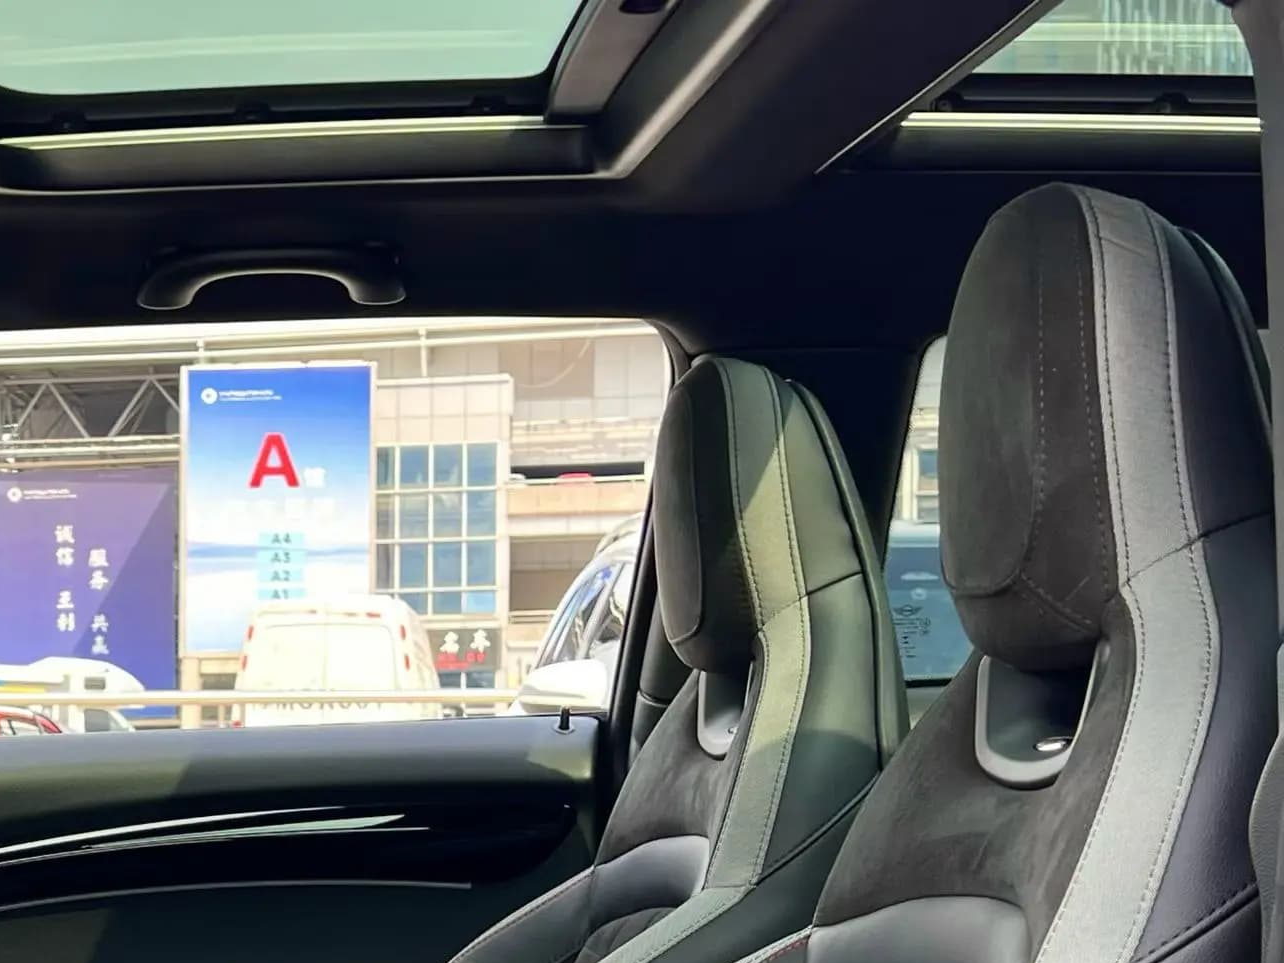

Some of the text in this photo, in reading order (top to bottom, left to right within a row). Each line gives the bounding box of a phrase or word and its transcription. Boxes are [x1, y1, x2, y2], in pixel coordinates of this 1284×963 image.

[248, 432, 300, 489] A
[271, 532, 293, 545] A4
[270, 551, 292, 564] A3
[270, 570, 292, 582] A2
[270, 589, 290, 600] A1
